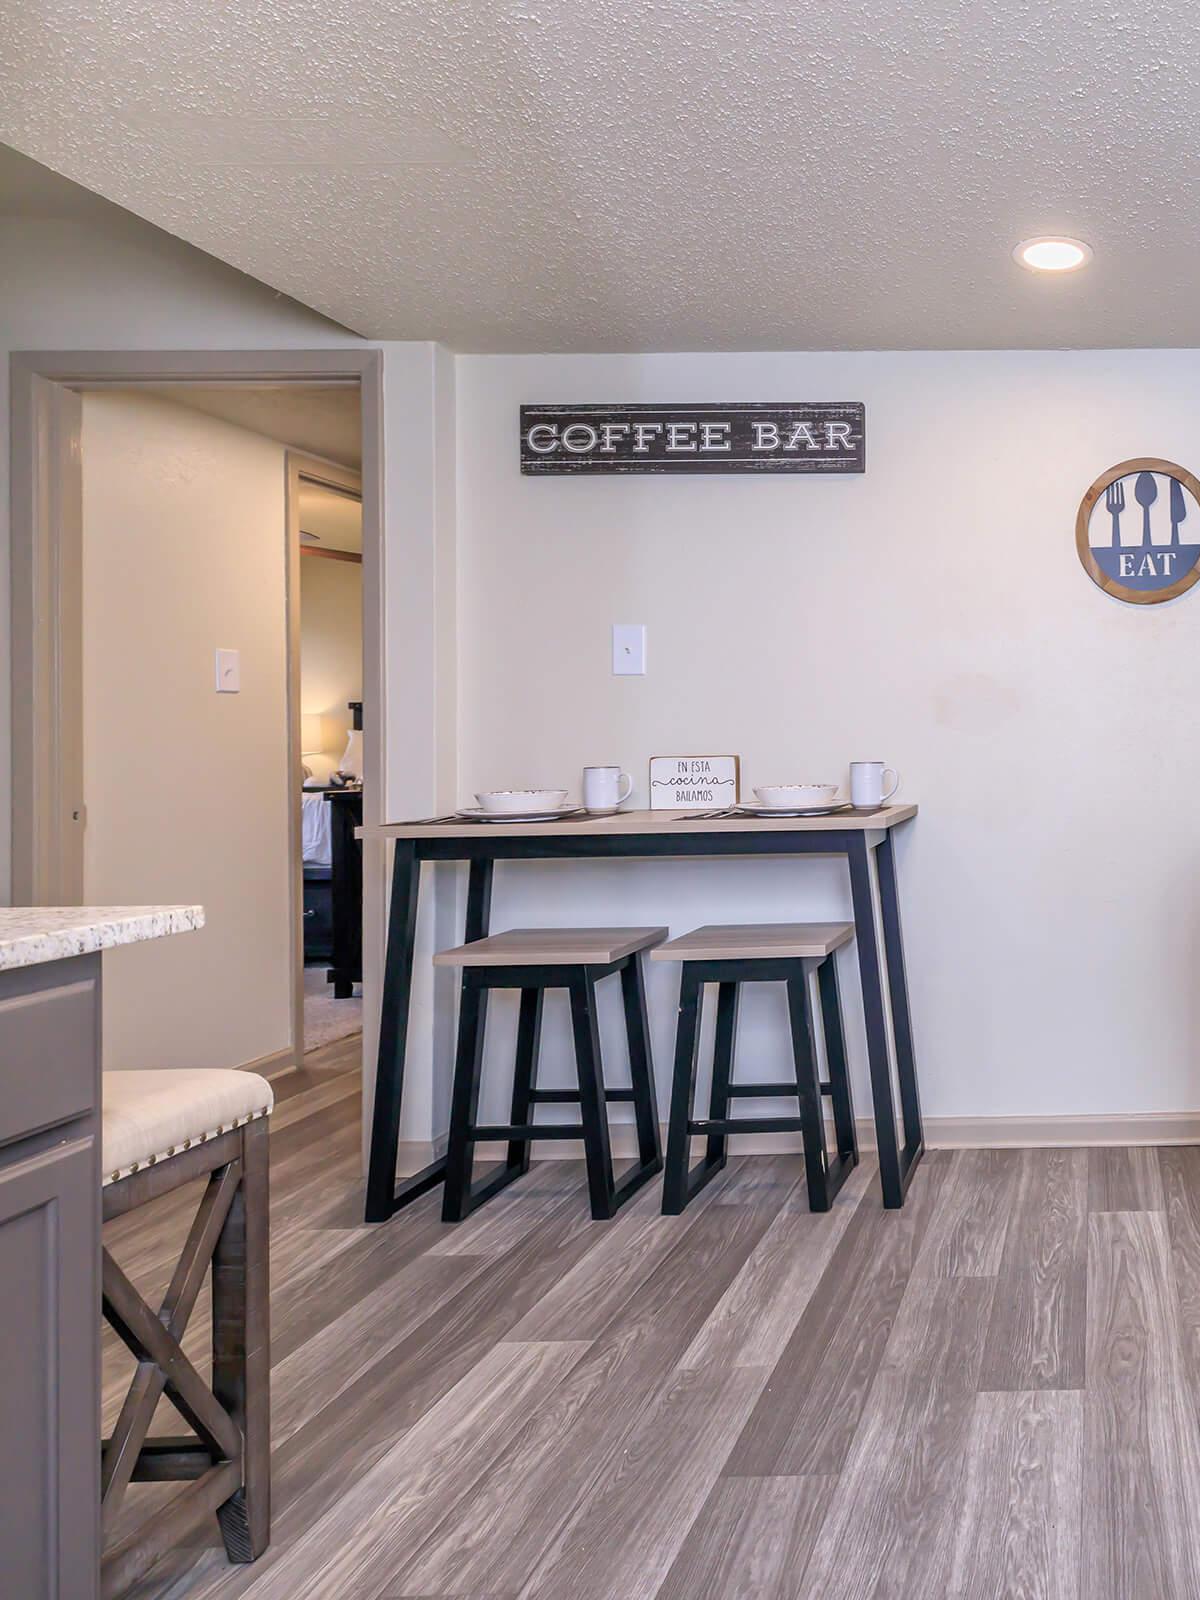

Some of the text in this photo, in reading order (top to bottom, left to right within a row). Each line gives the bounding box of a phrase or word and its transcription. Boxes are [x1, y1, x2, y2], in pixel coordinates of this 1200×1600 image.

[526, 421, 856, 453] COFFEE BAR
[1119, 552, 1177, 577] EAT
[677, 760, 711, 773] EN ESTA
[652, 774, 735, 787] cocina
[675, 790, 713, 802] BAILAMOS
